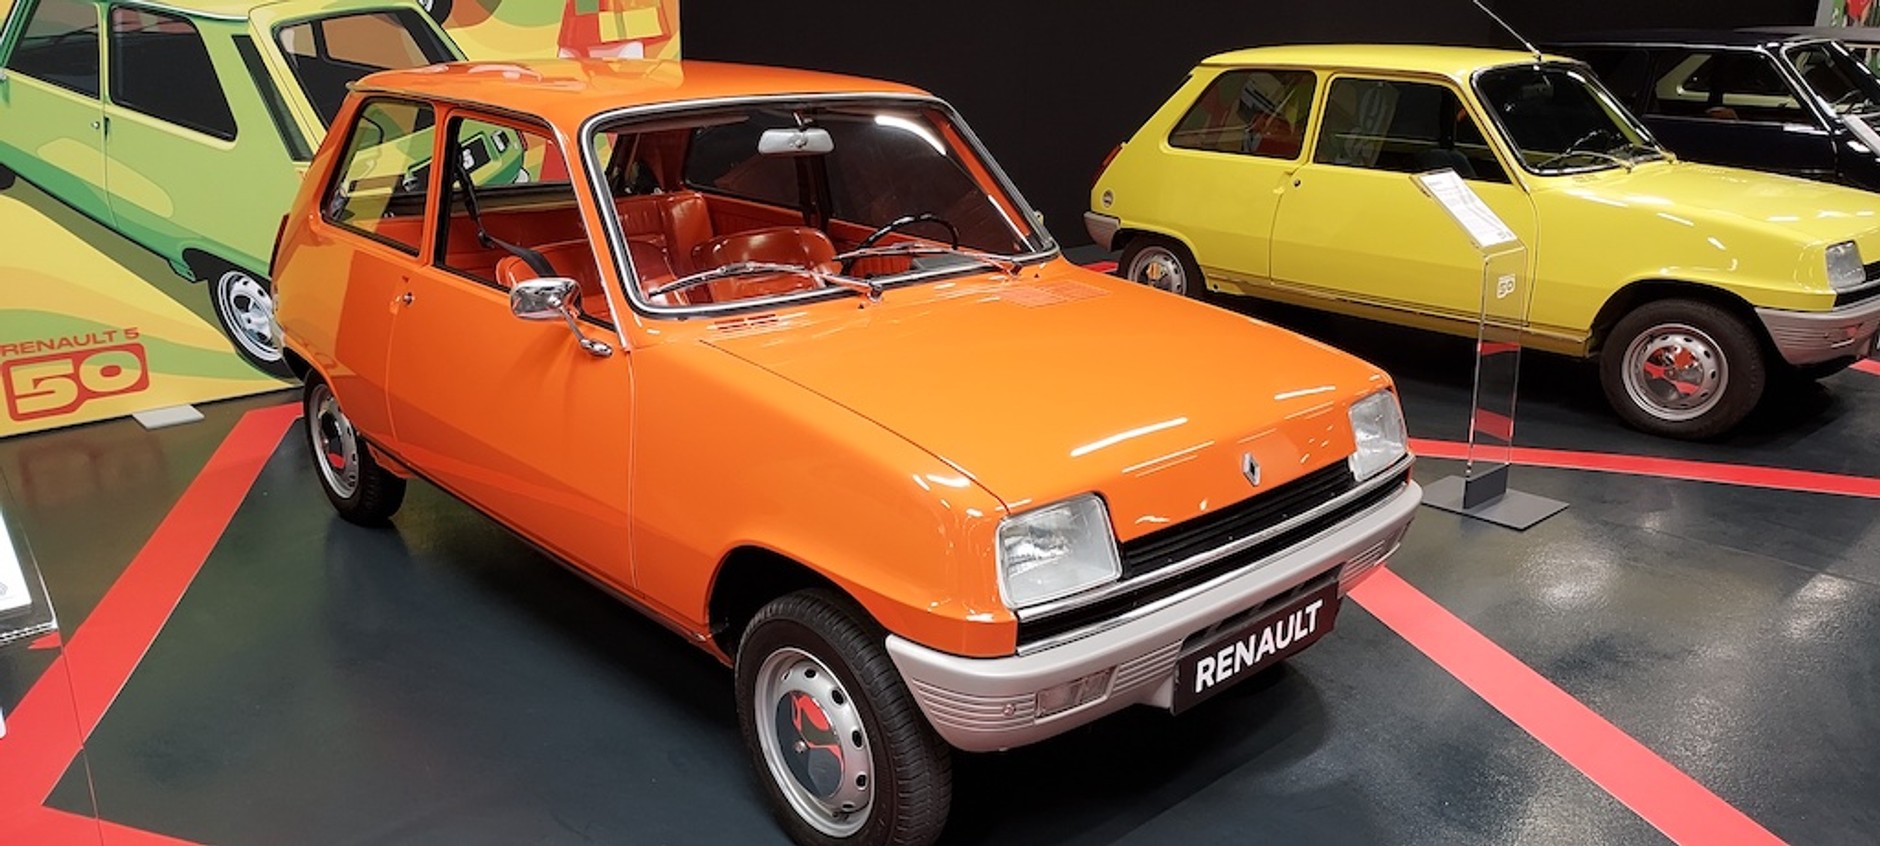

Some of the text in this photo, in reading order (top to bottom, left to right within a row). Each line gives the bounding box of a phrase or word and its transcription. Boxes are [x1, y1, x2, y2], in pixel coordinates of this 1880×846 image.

[0, 327, 140, 357] RENAULT 5
[10, 351, 142, 415] 50
[1195, 599, 1323, 693] RENAULT
